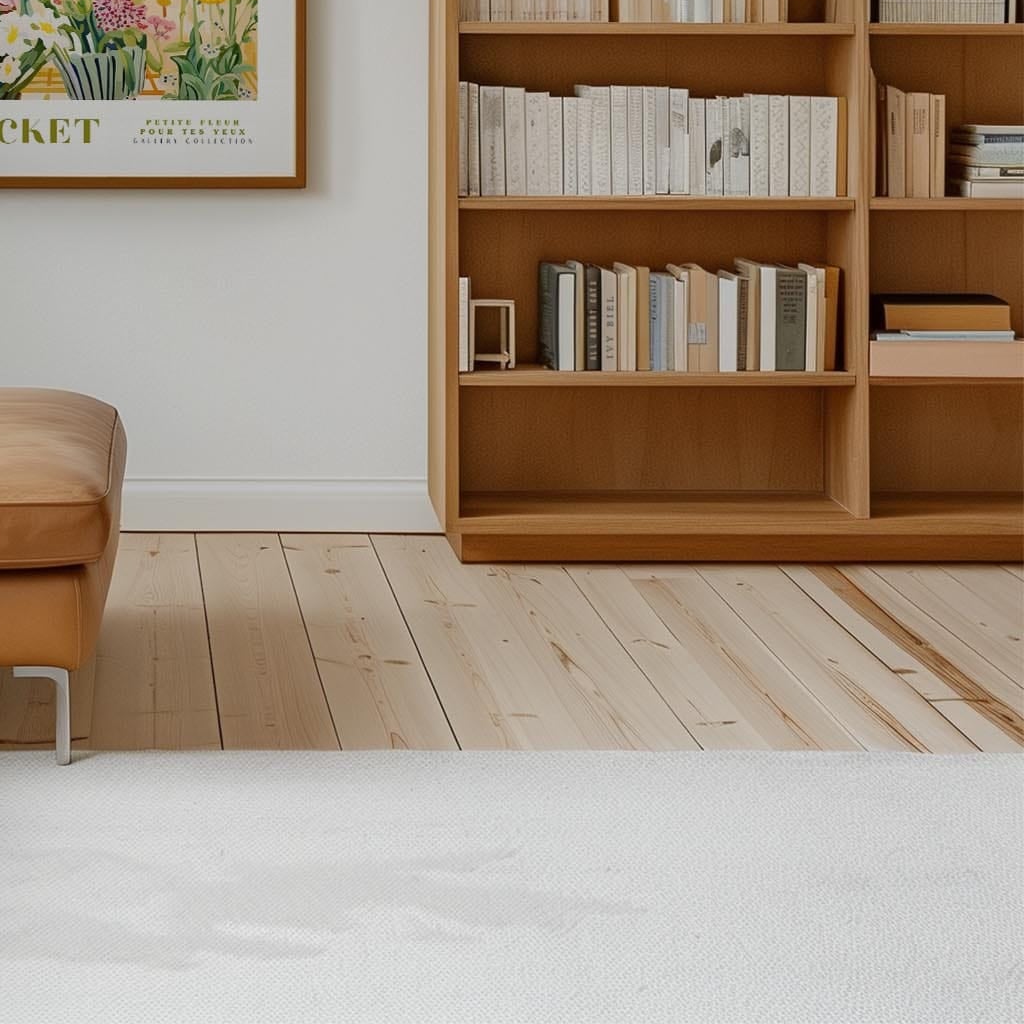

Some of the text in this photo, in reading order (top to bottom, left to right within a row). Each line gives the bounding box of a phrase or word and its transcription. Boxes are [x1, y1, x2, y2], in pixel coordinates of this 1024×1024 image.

[606, 296, 615, 359] IVY BIEL
[589, 344, 598, 361] ALL
